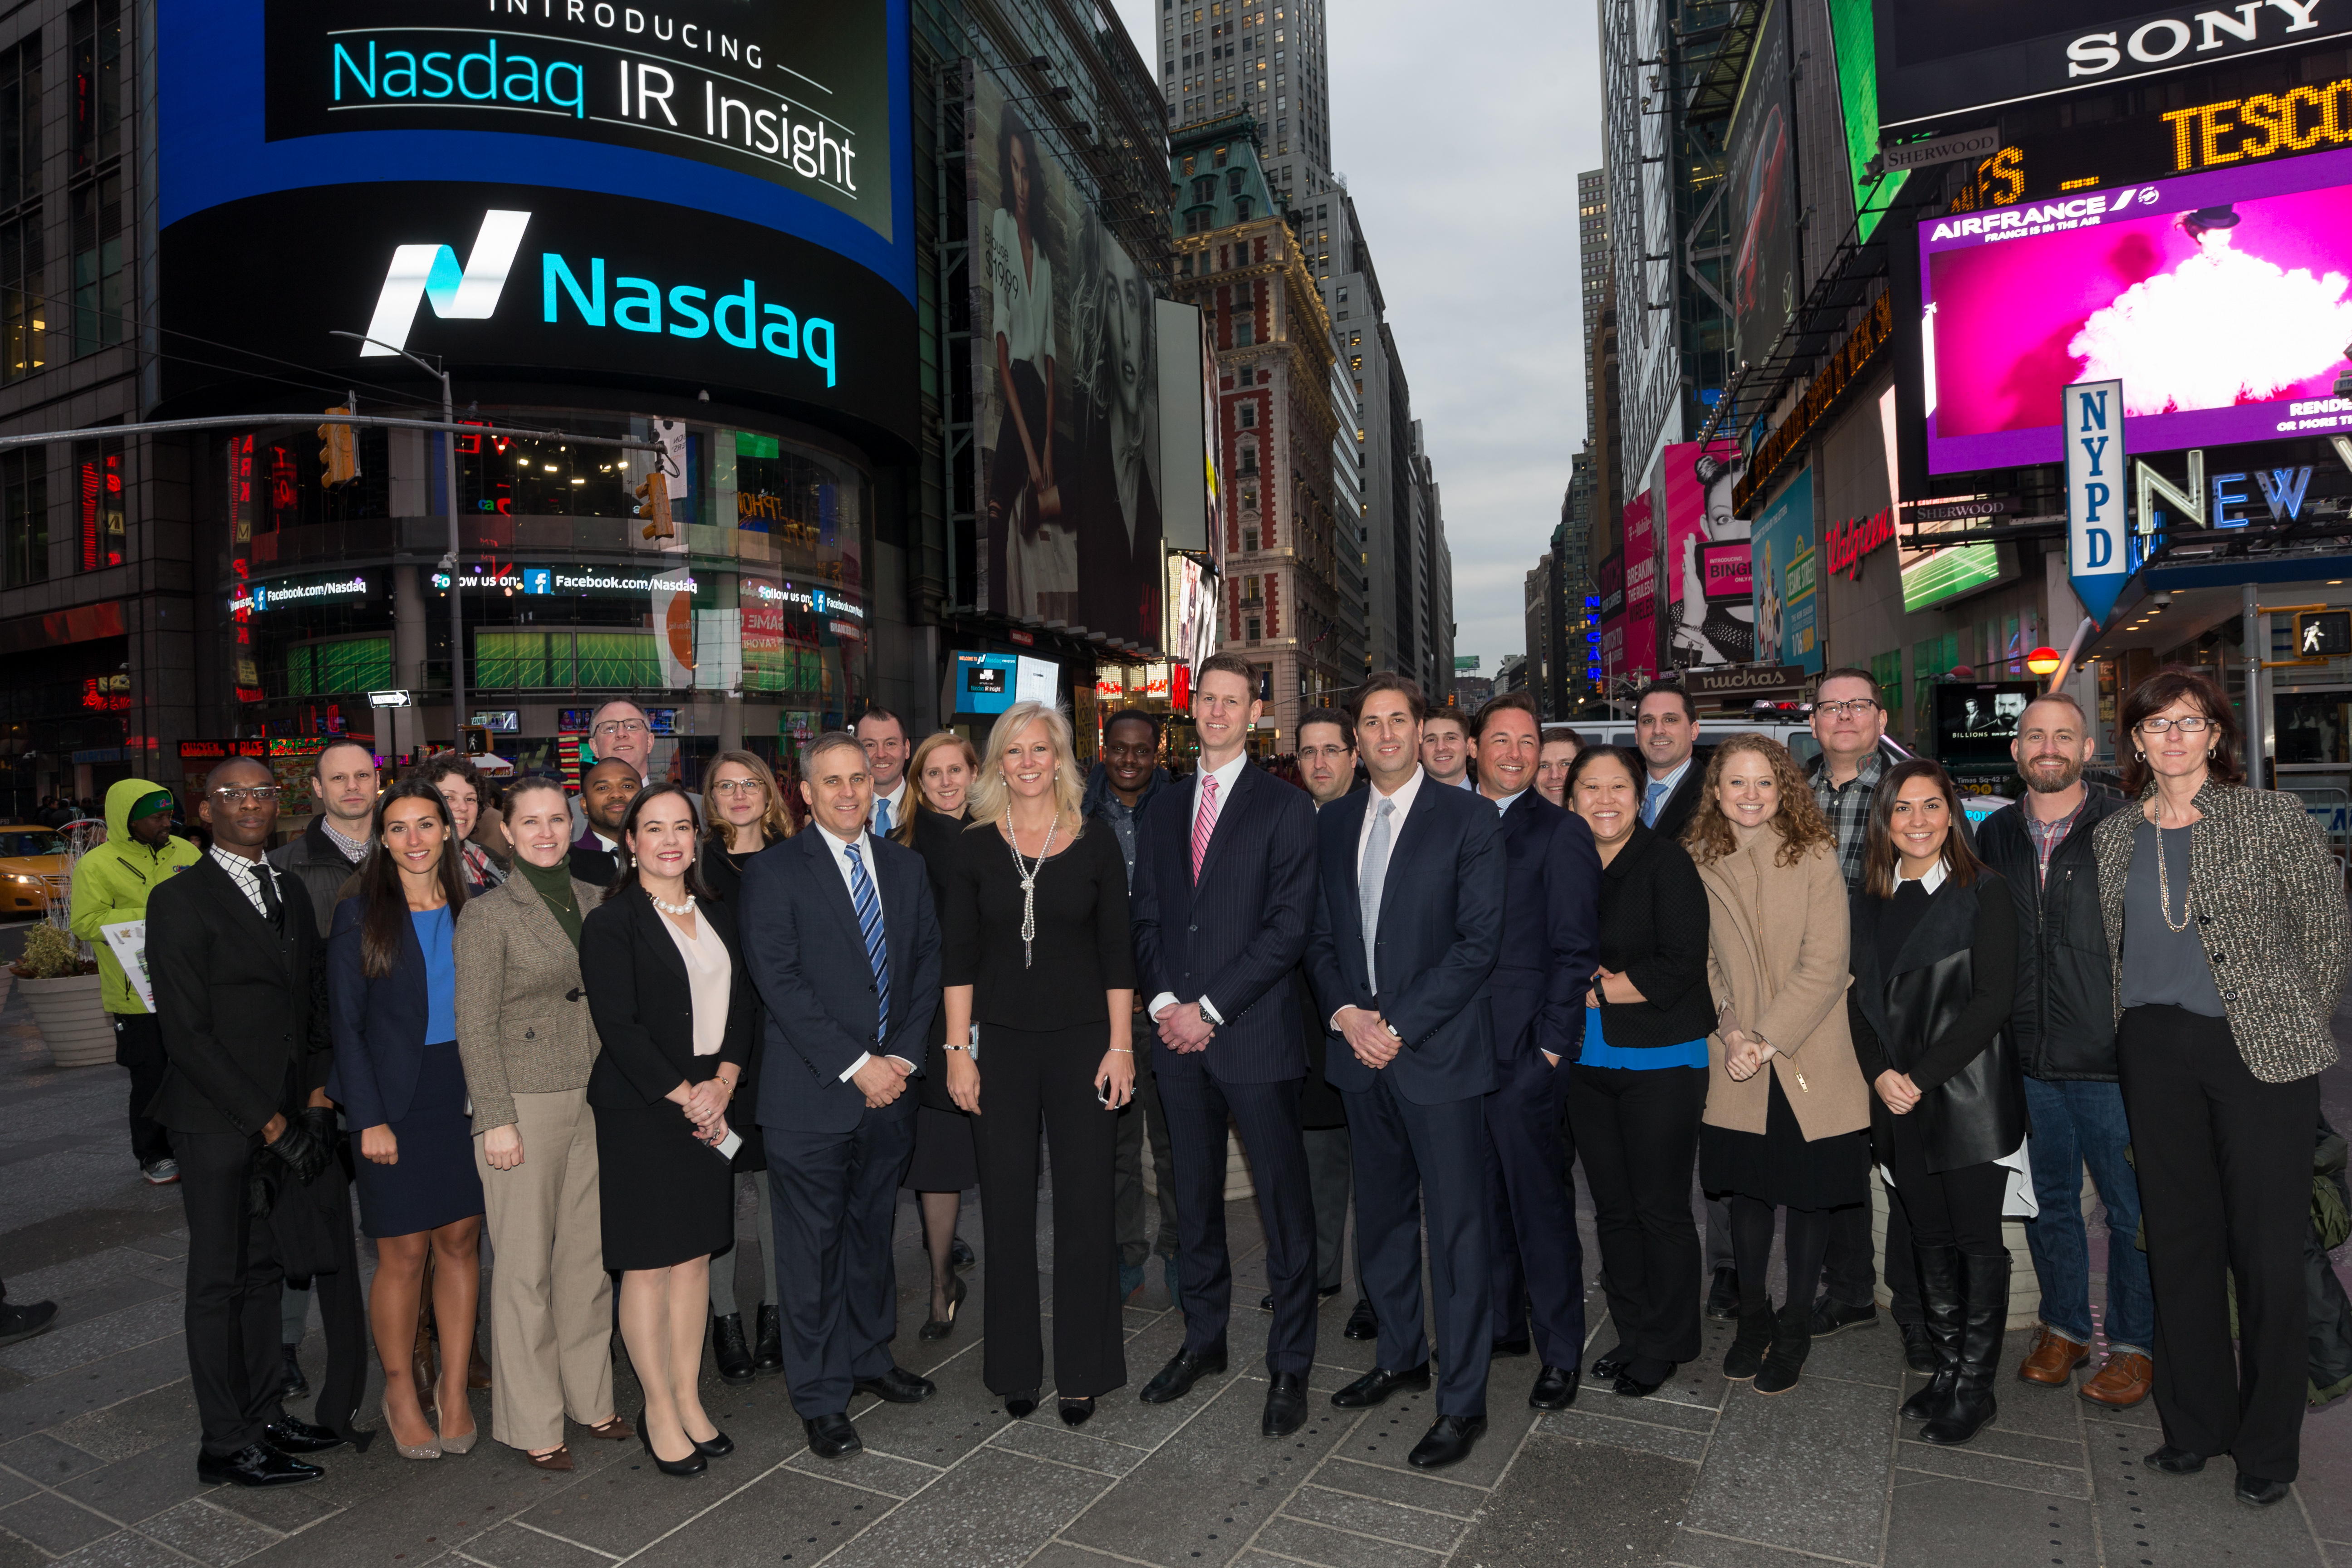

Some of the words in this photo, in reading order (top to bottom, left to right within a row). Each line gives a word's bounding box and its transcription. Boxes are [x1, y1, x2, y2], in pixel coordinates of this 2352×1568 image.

[2067, 0, 2332, 78] SONY
[334, 39, 583, 118] Nasdaq
[620, 59, 678, 126] IR
[706, 80, 856, 191] Insight
[2162, 78, 2352, 170] TESCO
[1888, 136, 1994, 167] SHERWOOD
[1985, 228, 2028, 242] FRANCE
[2030, 225, 2040, 235] IS
[2043, 224, 2054, 233] IN
[2056, 219, 2078, 230] THE
[2079, 216, 2101, 227] AIR
[985, 225, 1009, 262] Blouse
[985, 248, 1019, 300] $19.99
[543, 253, 836, 388] Nasdaq
[2276, 421, 2297, 431] OR
[2298, 416, 2337, 430] MORE
[2079, 390, 2112, 568] NYPD
[1917, 502, 2004, 521] SHERWOOD
[1825, 505, 1895, 581] Walgreens
[481, 577, 497, 587] us
[555, 575, 698, 594] Facebook.com/Nasdaq
[1601, 554, 1622, 600] DITCH
[1788, 566, 1802, 598] SESAME
[1801, 556, 1815, 589] STREET
[267, 580, 366, 602] Facebook.com/Nasdaq
[760, 588, 789, 601] Follow
[790, 593, 799, 602] us
[1609, 589, 1622, 609] CARRIER
[1627, 588, 1637, 604] THE
[1637, 582, 1650, 601] RULES
[1803, 604, 1813, 618] SEASON
[1585, 595, 1602, 690] NYGÅR
[1602, 630, 1616, 653] SWITCH
[1616, 626, 1622, 647] TO
[1802, 625, 1814, 653] HBO
[1702, 670, 1786, 689] nuchas
[1078, 688, 1091, 705] NEW
[1077, 707, 1093, 725] YORK
[1076, 724, 1094, 741] WATER
[1080, 740, 1092, 757] TAXI
[1965, 810, 1993, 822] POL
